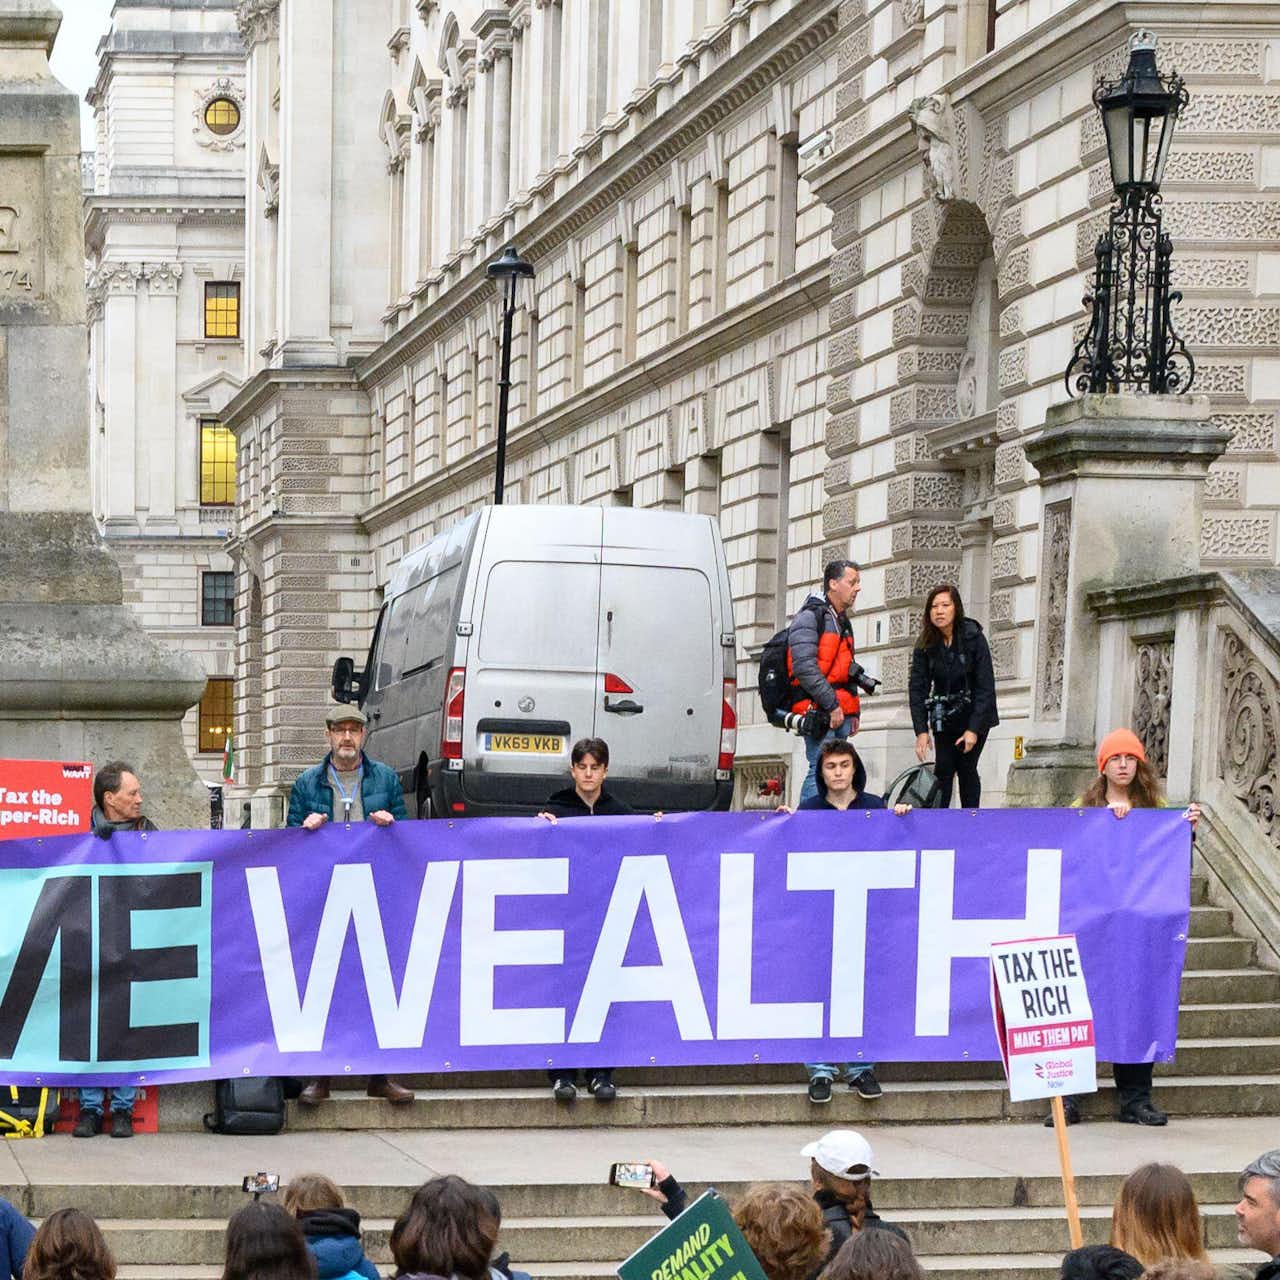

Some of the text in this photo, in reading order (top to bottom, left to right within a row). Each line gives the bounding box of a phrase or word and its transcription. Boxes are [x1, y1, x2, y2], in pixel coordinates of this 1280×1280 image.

[495, 735, 560, 751] VK69 VKB
[31, 789, 63, 805] the
[245, 849, 1061, 1053] WEALTH
[998, 948, 1078, 984] TAX THE
[1021, 985, 1071, 1019] RICH
[1013, 1025, 1088, 1049] MAKE THEM PAY
[1045, 1059, 1073, 1070] Global
[1047, 1069, 1073, 1080] Justice
[1047, 1080, 1065, 1089] Now
